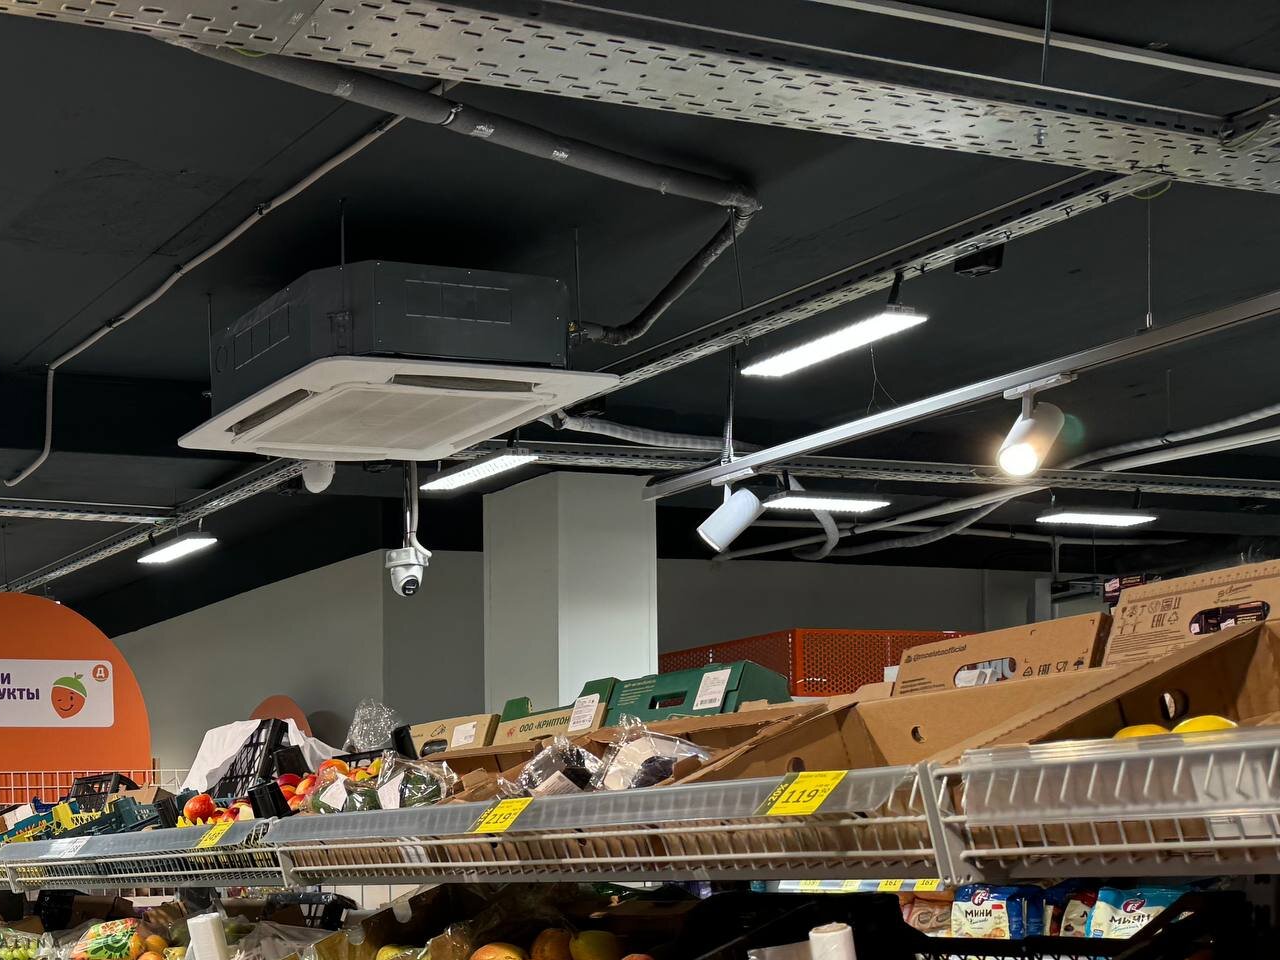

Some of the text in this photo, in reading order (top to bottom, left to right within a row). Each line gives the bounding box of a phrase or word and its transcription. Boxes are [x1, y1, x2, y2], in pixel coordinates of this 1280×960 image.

[519, 722, 534, 733] ООО
[781, 788, 819, 804] 119
[485, 812, 513, 825] 219
[965, 908, 993, 918] МИНИ
